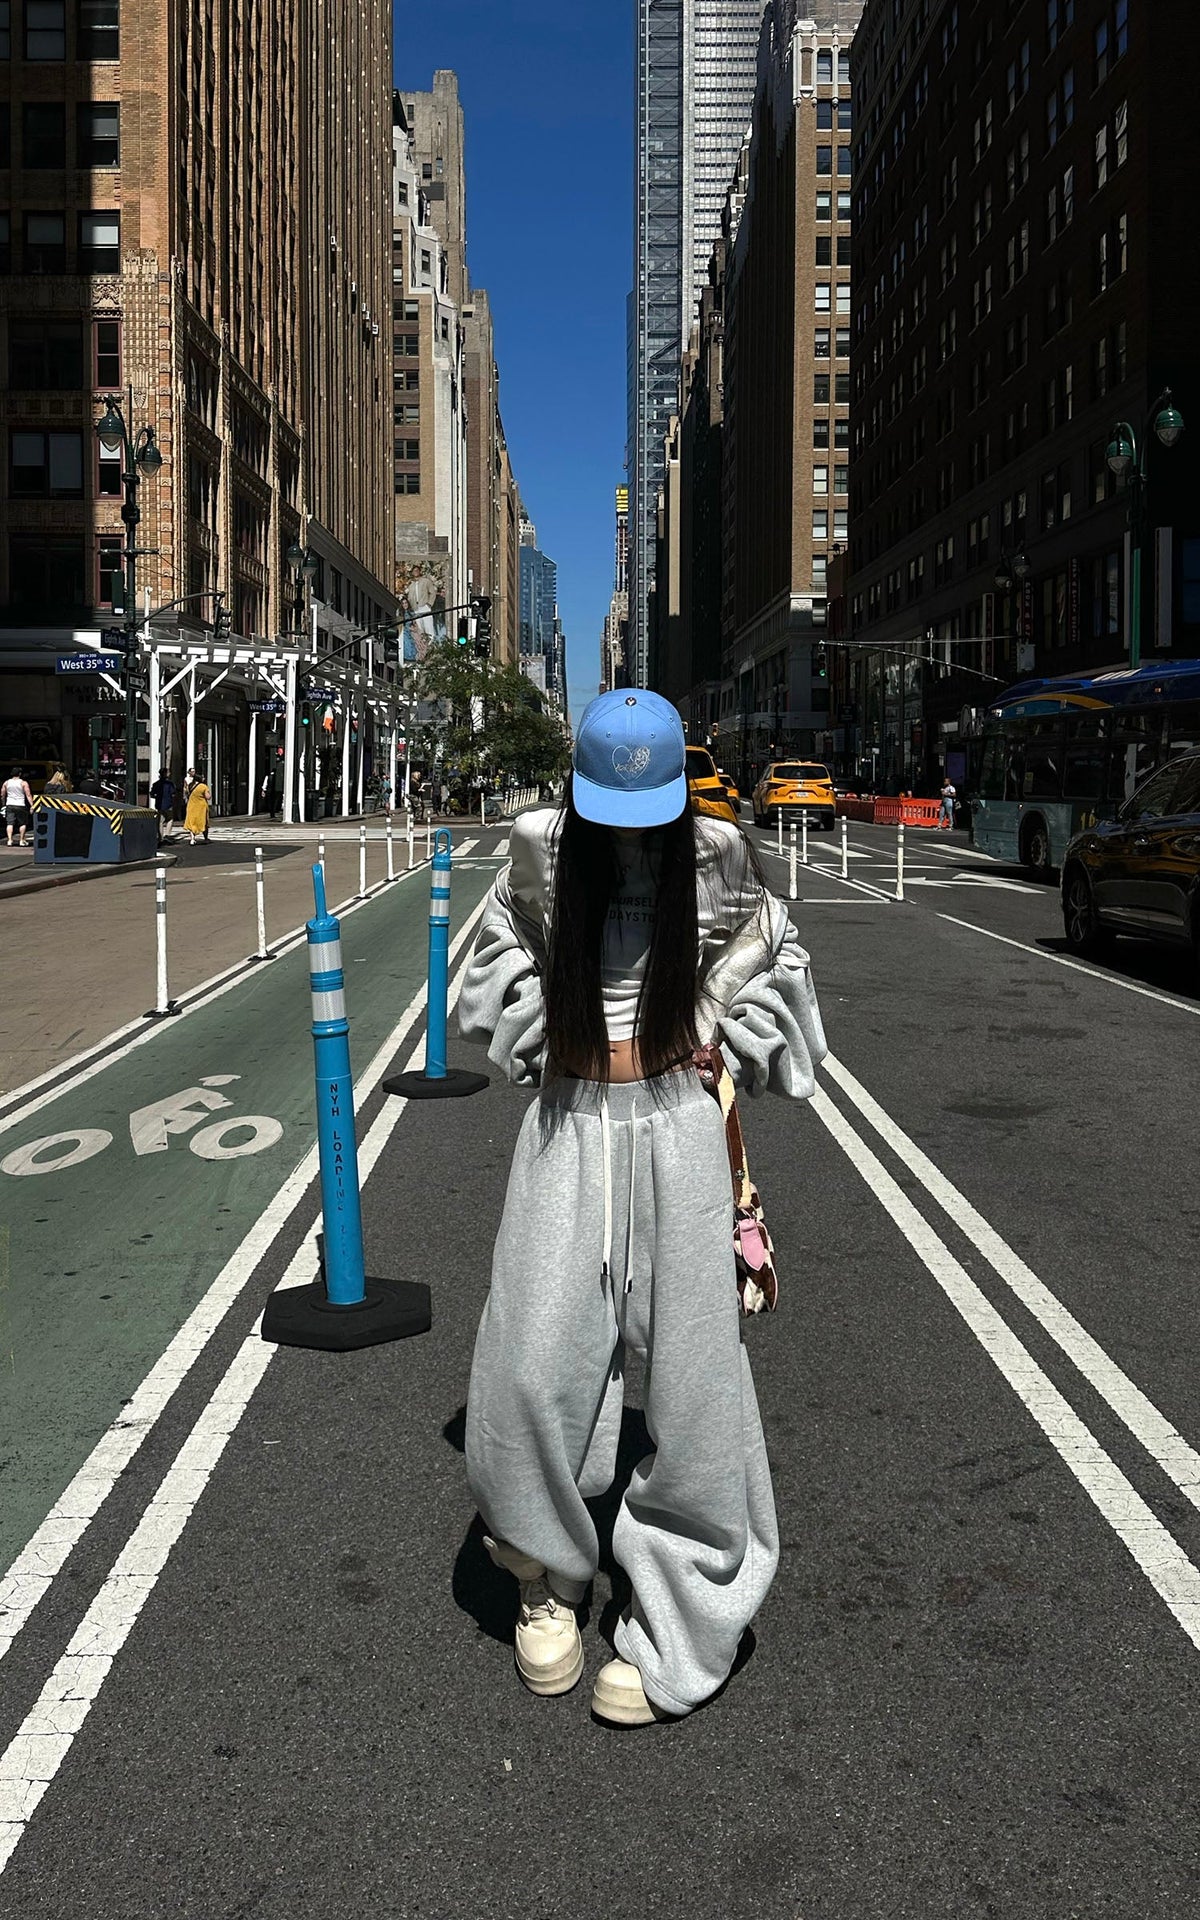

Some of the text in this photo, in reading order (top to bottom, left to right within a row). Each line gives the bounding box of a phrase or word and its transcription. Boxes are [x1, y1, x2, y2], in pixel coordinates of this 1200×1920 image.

[60, 658, 115, 670] West 35th St
[321, 692, 333, 701] Ave
[249, 703, 265, 711] West
[278, 703, 286, 711] St
[329, 1083, 340, 1117] NYH
